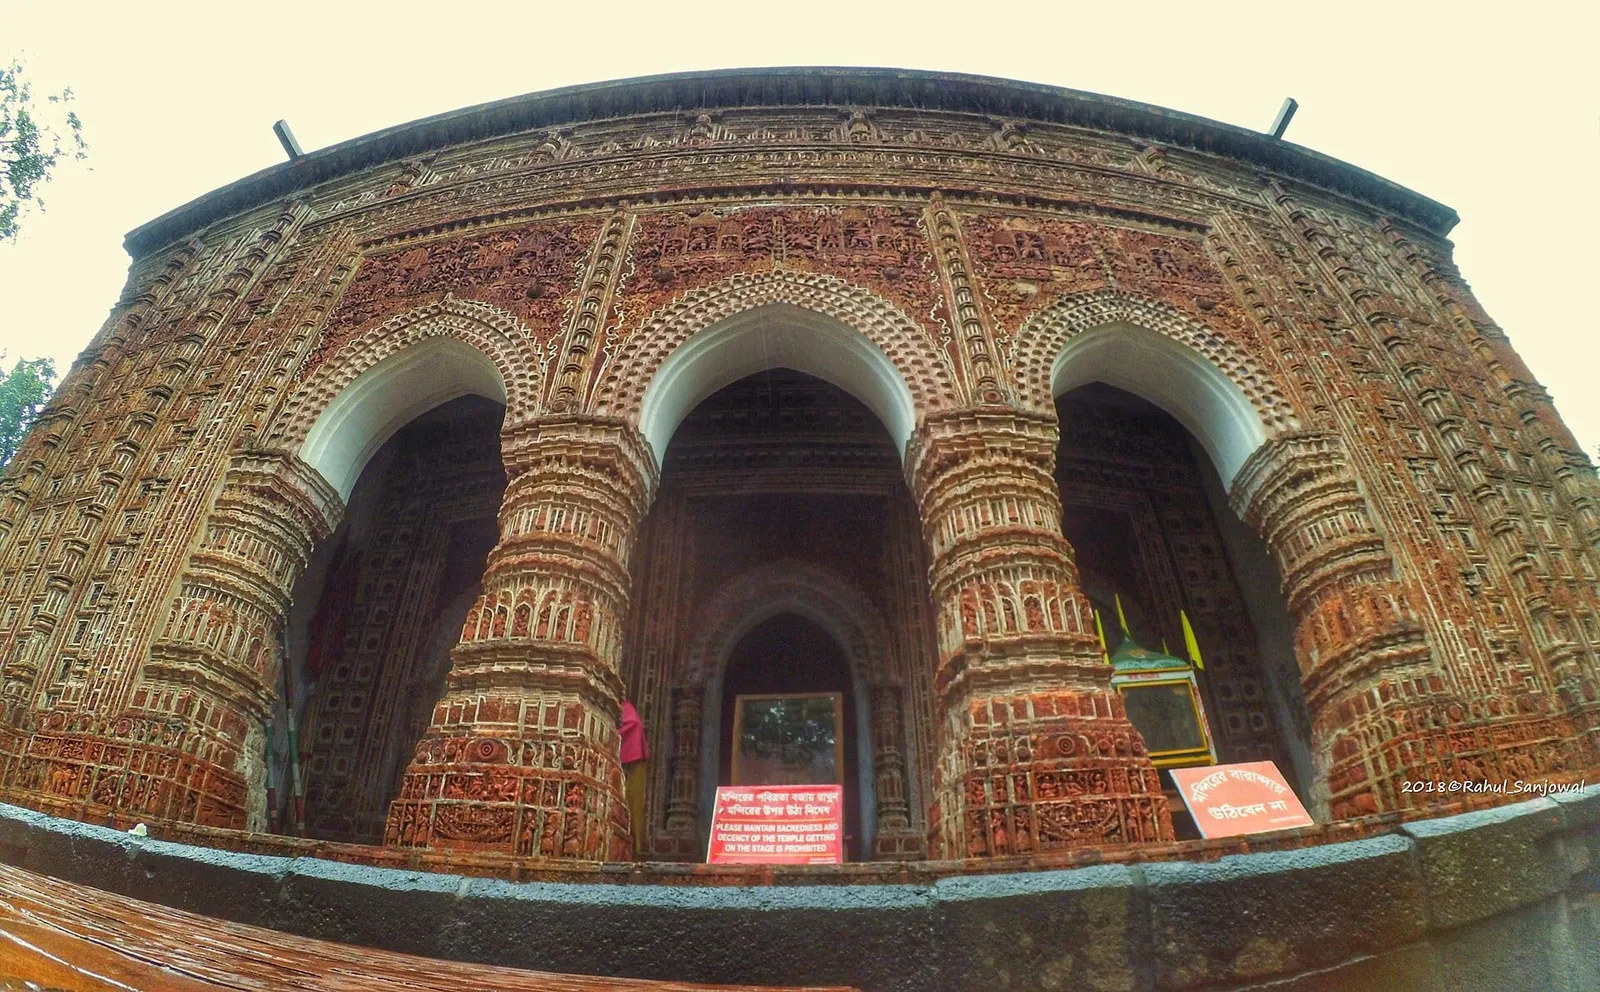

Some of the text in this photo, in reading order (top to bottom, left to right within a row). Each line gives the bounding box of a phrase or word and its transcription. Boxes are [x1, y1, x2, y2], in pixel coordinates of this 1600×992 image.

[1268, 799, 1289, 812] না
[716, 823, 838, 832] PLEASE MAINTAIN SACREDNESS AND
[717, 834, 836, 842] DECENCY OF THE TEMPLE GETTING
[725, 844, 827, 853] ON THE STAGE IS PROHIBITED
